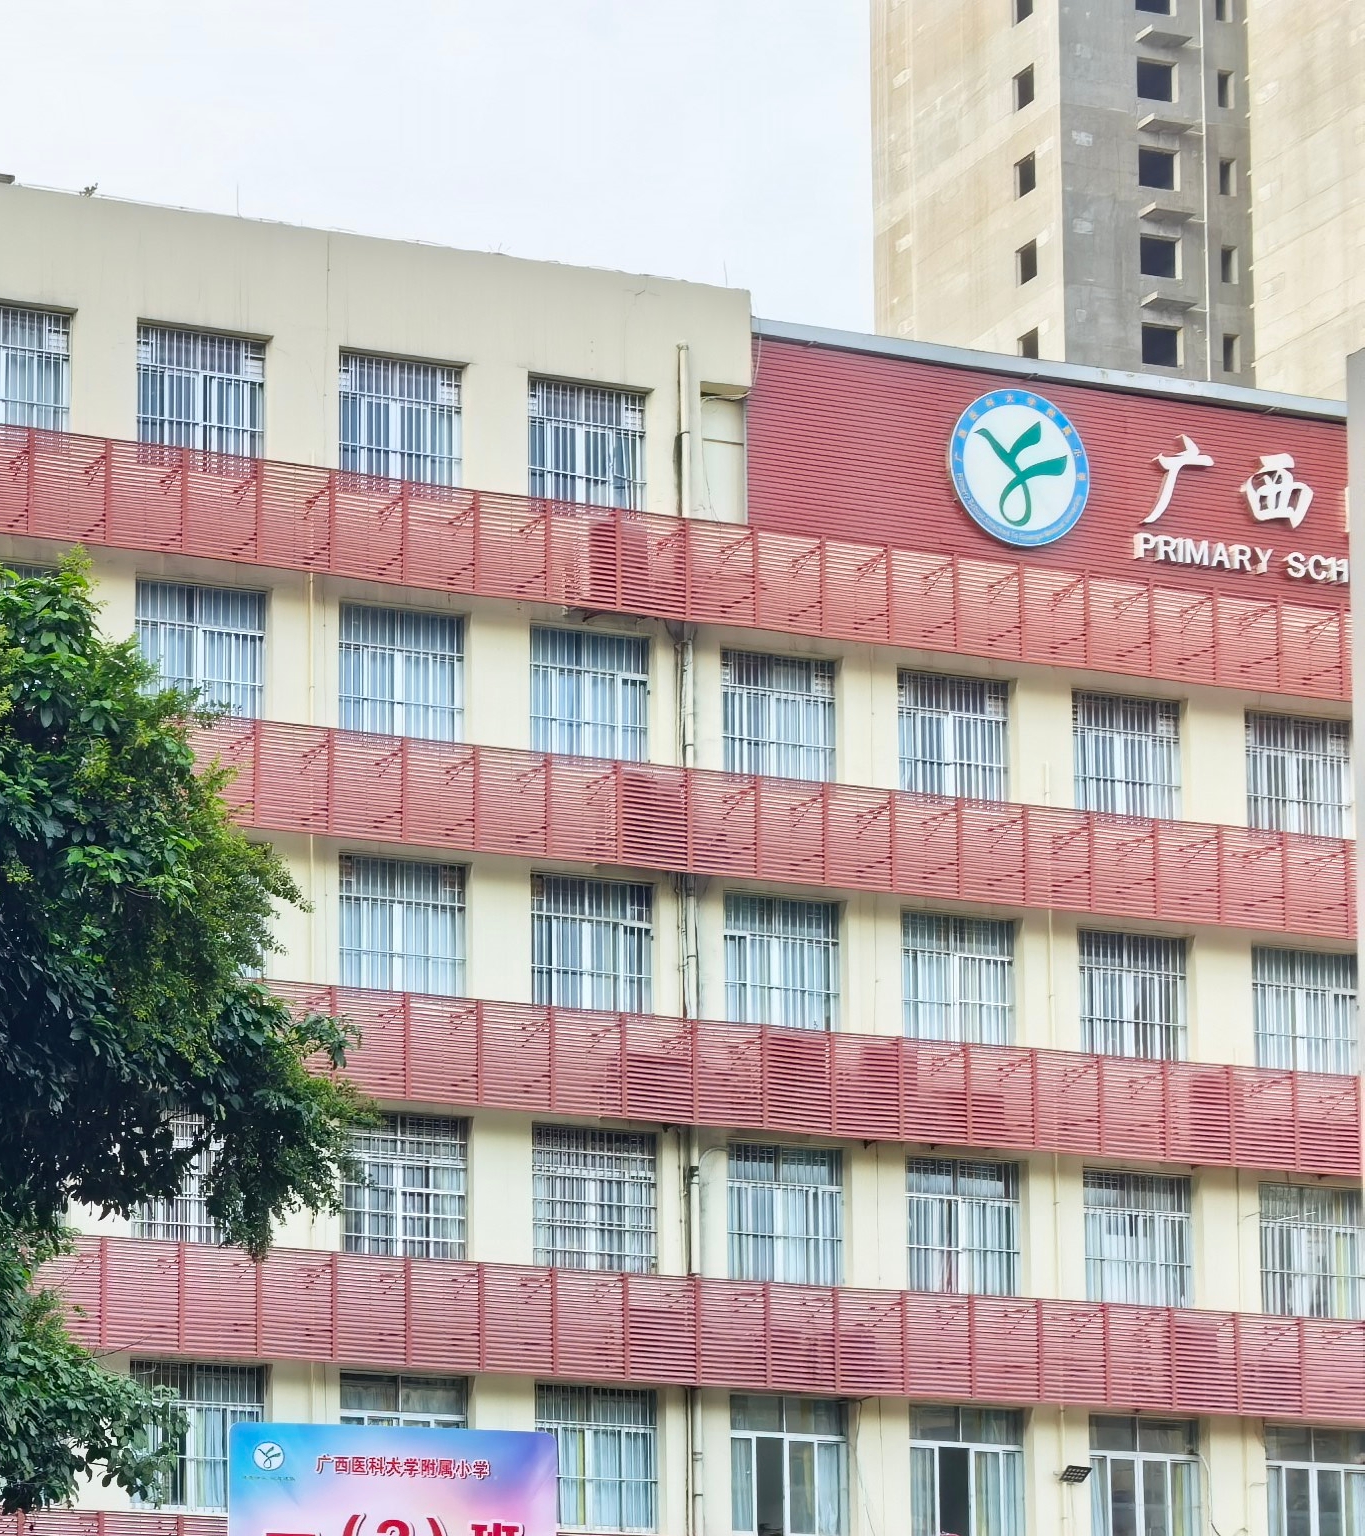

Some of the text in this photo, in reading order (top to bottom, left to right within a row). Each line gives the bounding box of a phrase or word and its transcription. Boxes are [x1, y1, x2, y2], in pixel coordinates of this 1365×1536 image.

[1134, 532, 1349, 583] PRIMARY SCH
[316, 1454, 490, 1479] 广西医科大学附属小学
